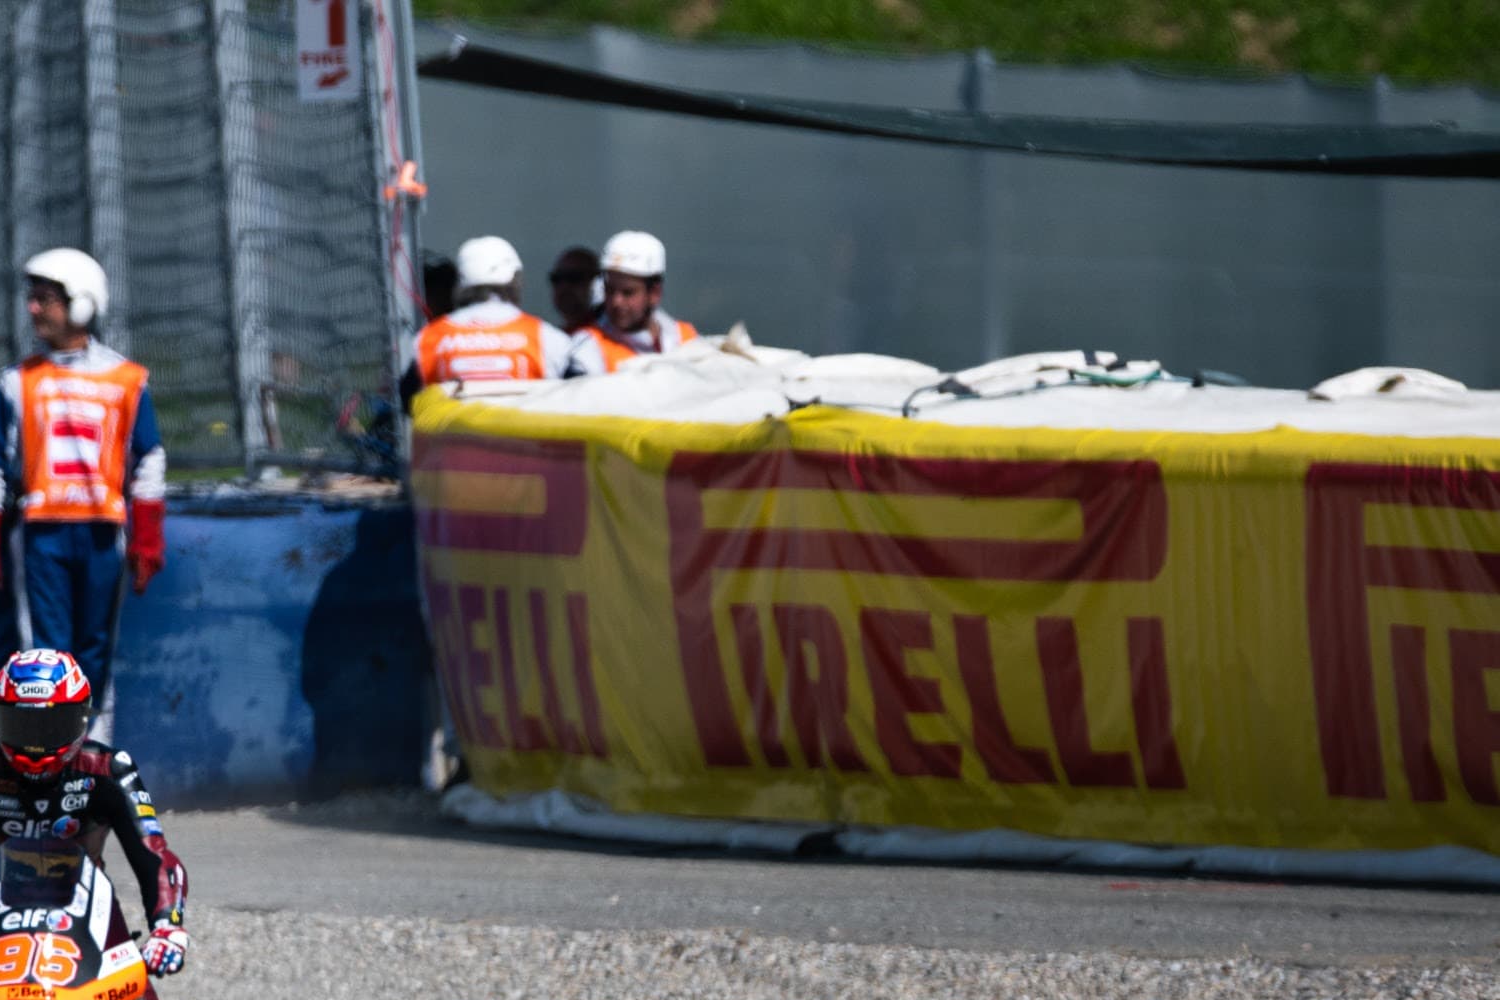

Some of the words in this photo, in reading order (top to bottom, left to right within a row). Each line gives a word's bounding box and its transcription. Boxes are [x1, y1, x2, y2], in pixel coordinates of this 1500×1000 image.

[665, 449, 1187, 790] PIRELLI
[63, 779, 84, 793] elf
[1, 908, 47, 931] elf
